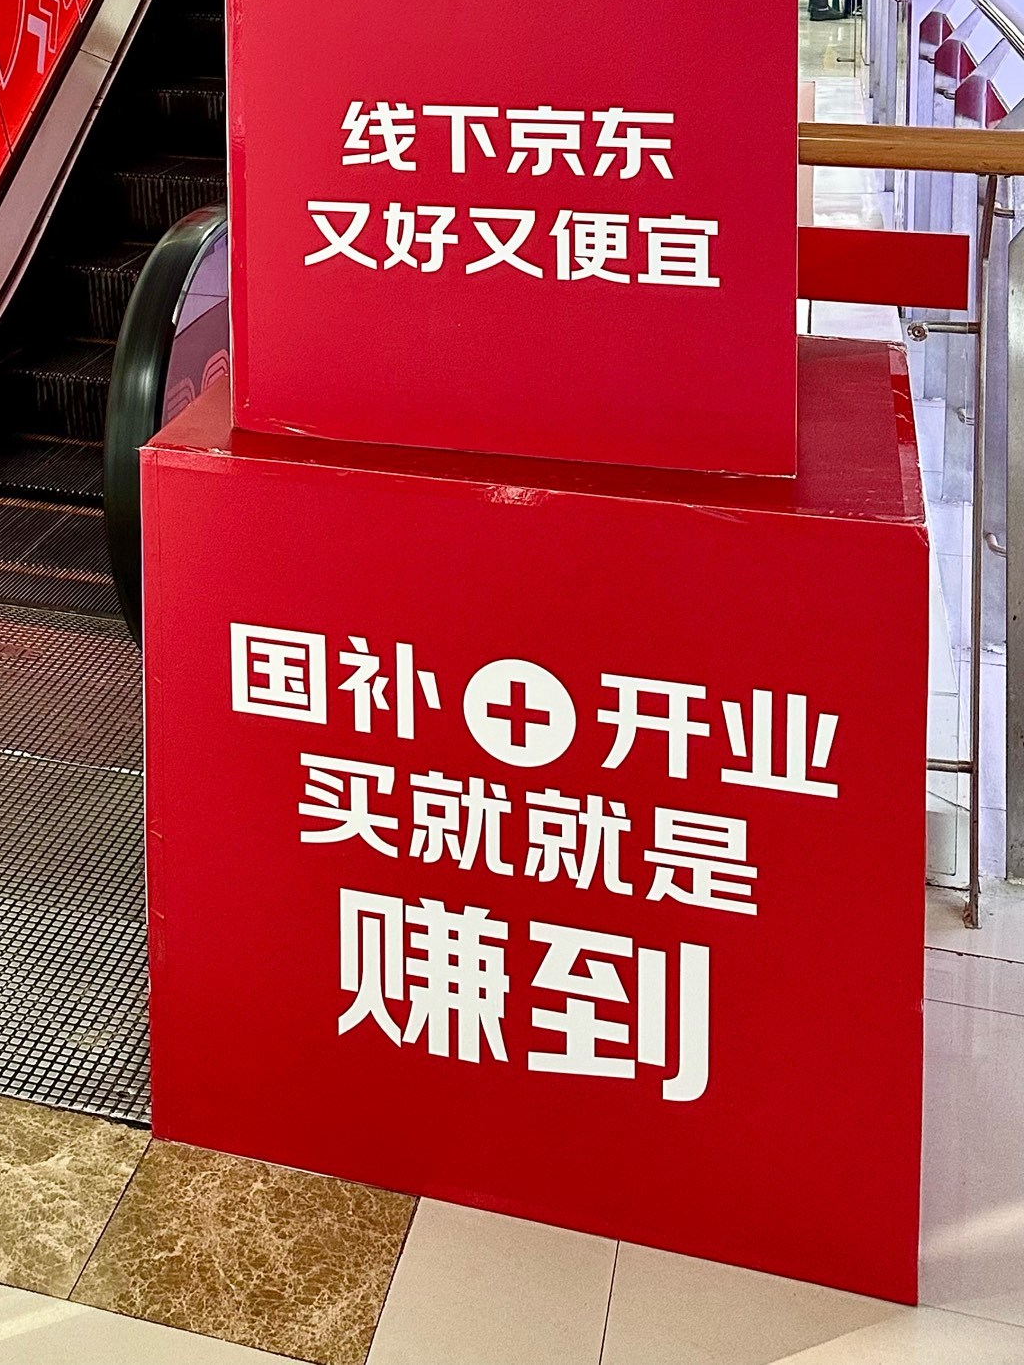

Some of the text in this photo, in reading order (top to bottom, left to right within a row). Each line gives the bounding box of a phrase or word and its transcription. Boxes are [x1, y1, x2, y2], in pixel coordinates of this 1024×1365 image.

[340, 100, 675, 180] 线下京东
[304, 200, 721, 288] 又好又便宜
[297, 751, 759, 916] 买就就是
[337, 887, 711, 1103] 赚到
